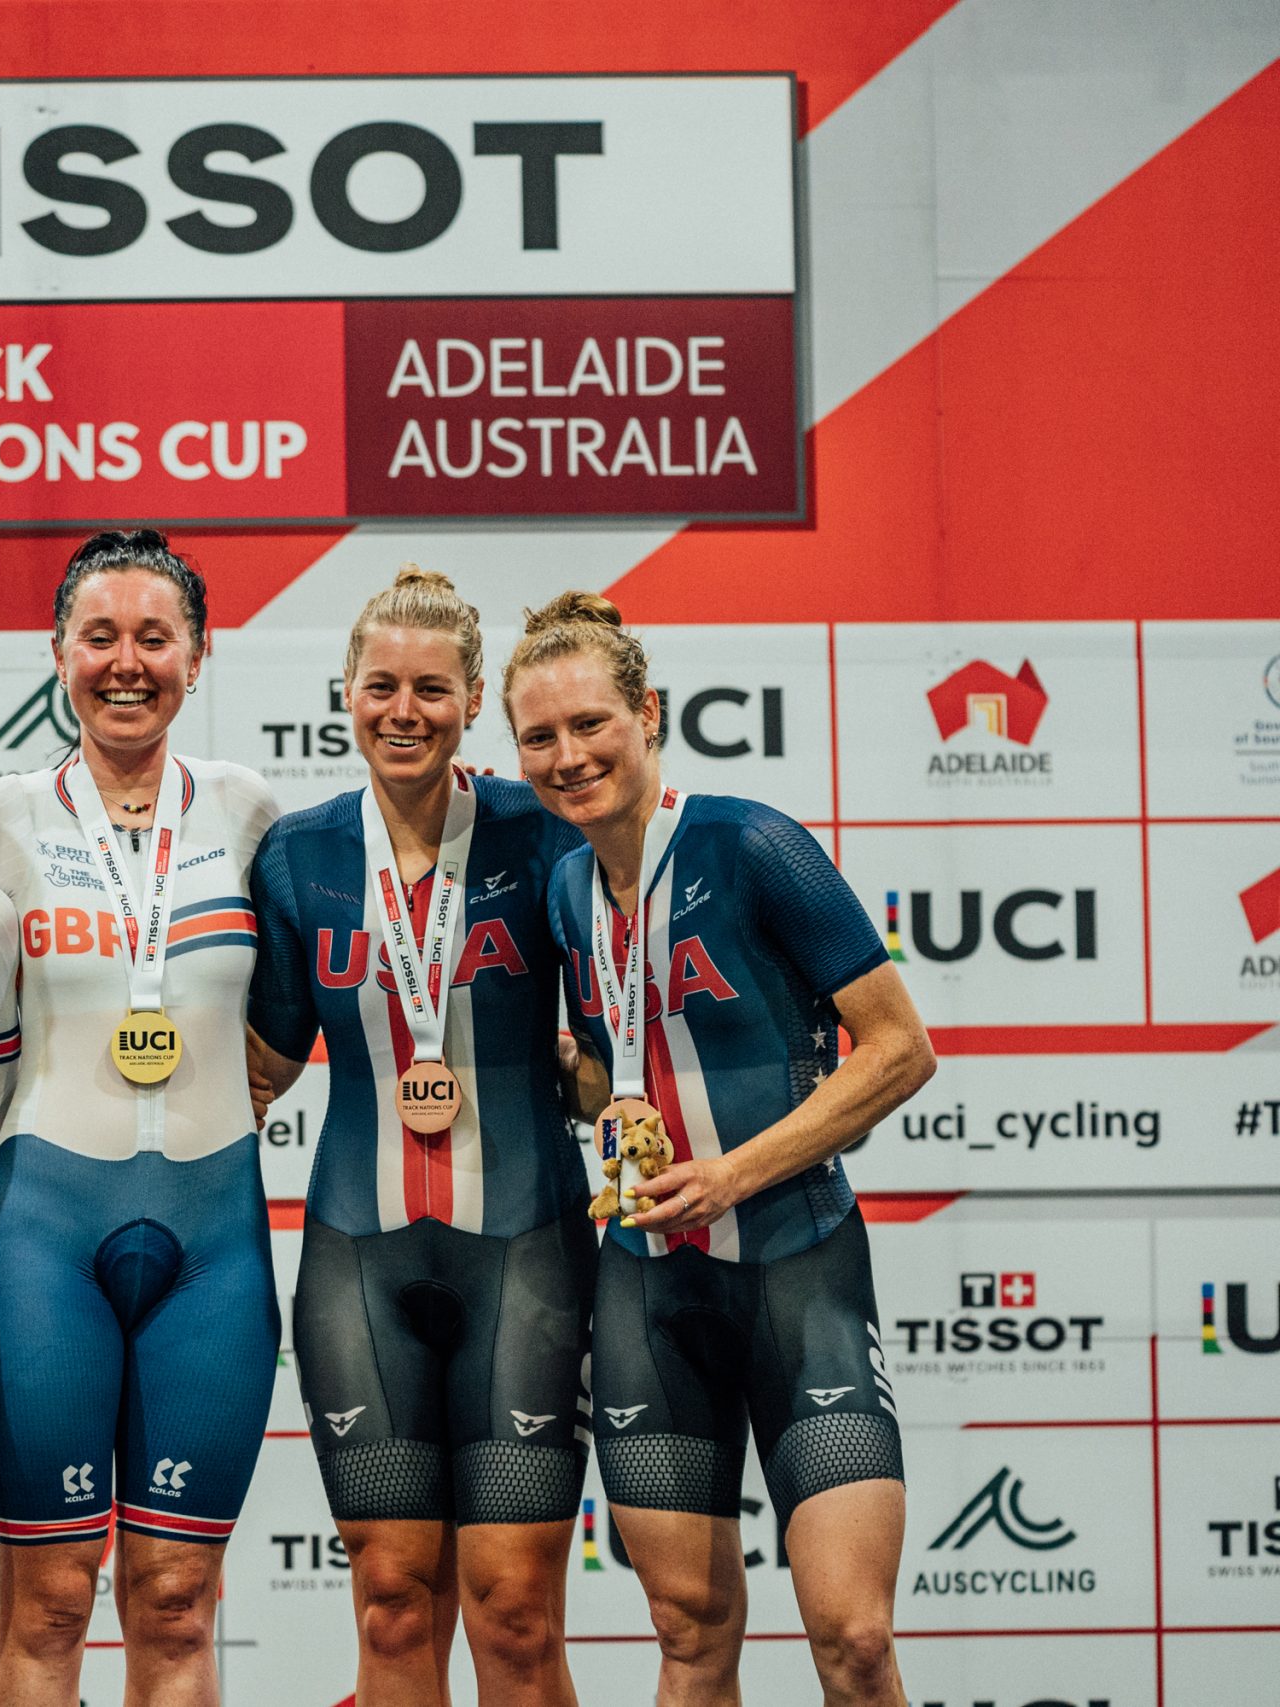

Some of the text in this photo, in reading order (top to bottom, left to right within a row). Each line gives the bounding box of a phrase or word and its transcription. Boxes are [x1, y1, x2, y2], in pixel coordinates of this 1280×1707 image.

[387, 334, 726, 398] ADELAIDE
[158, 419, 307, 483] CUP
[388, 412, 758, 480] AUSTRALIA
[657, 687, 785, 760] CI
[928, 752, 1052, 774] ADELAIDE
[70, 868, 90, 877] THE
[102, 849, 123, 887] TISSOT
[147, 904, 161, 945] TISSOT
[436, 888, 452, 929] TISSOT
[909, 888, 1099, 961] UCI
[597, 931, 608, 972] TISSOT
[400, 954, 420, 997] TISSOT
[626, 983, 637, 1028] TISSOT
[129, 1031, 176, 1051] UCI
[411, 1080, 454, 1101] UCI
[903, 1101, 1161, 1151] uci_cycling
[896, 1316, 1104, 1354] TISSOT
[895, 1362, 941, 1374] SWISS
[949, 1361, 1015, 1373] WATCHES
[1022, 1360, 1065, 1372] SINCE
[913, 1568, 1097, 1596] AUSCYCLING
